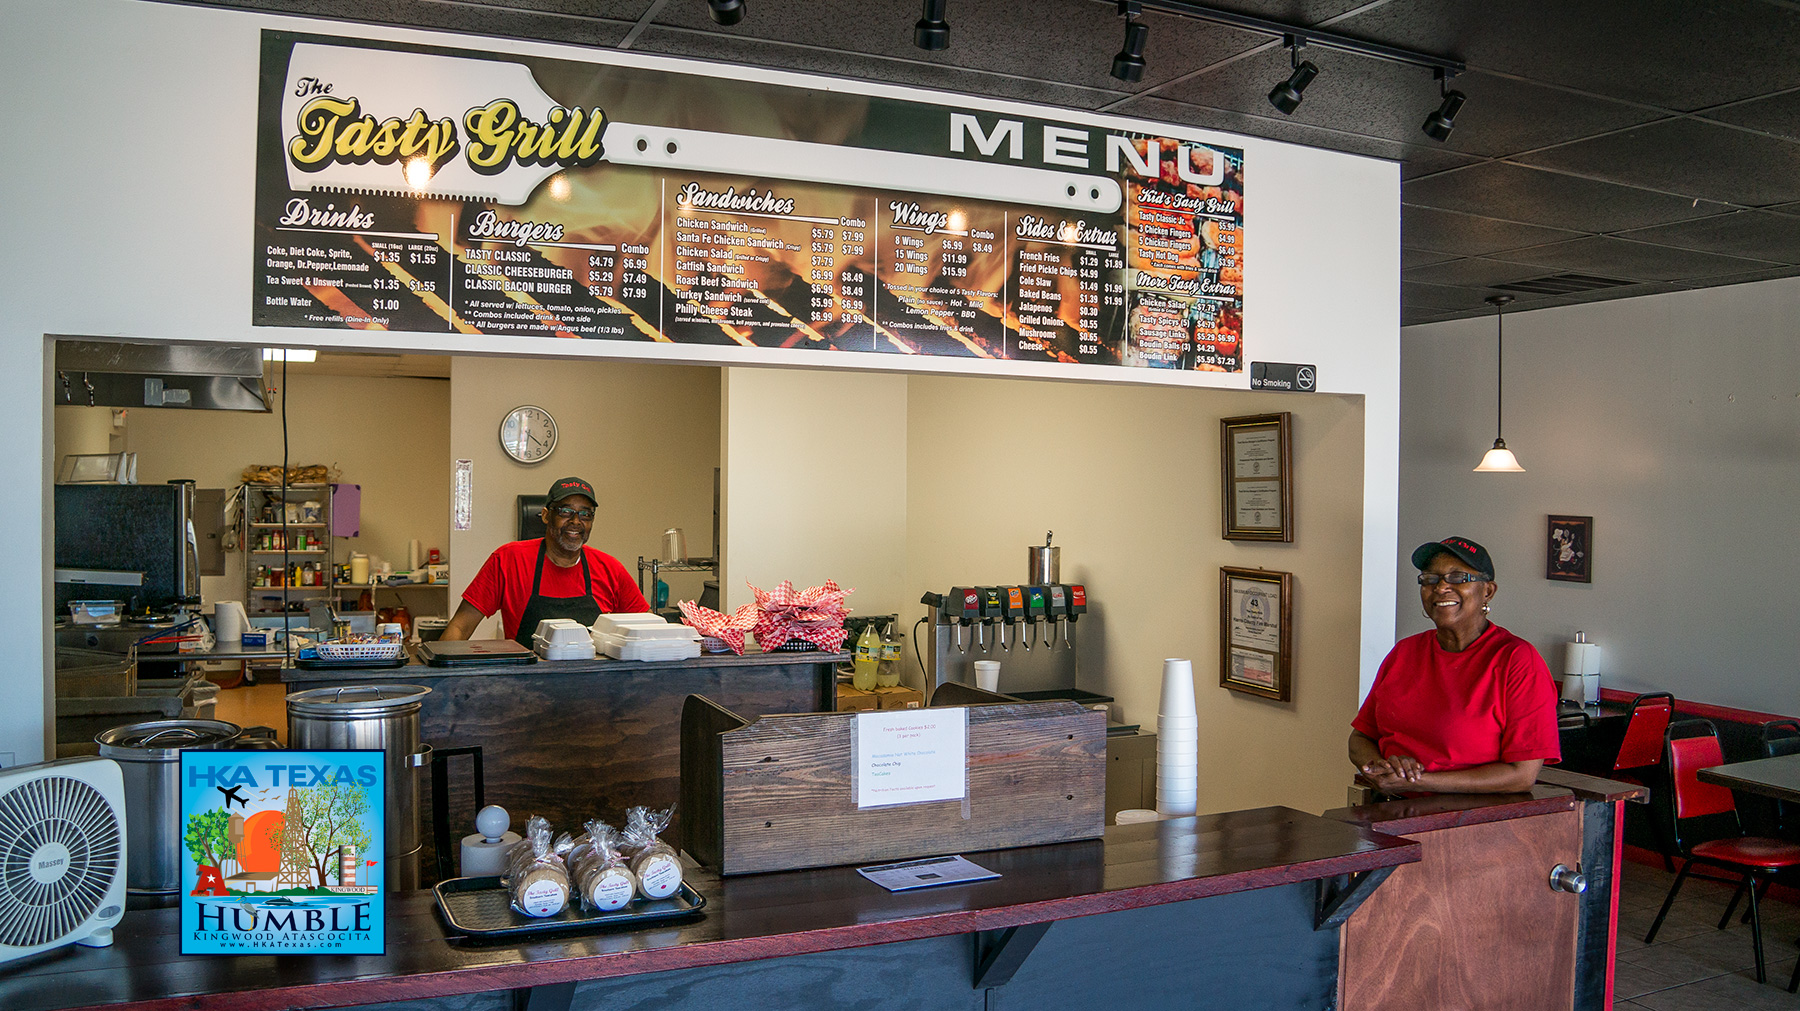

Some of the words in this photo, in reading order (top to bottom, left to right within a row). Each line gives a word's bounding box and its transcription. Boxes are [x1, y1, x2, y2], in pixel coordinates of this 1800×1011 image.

[295, 77, 334, 98] The
[288, 96, 460, 180] Tasty
[463, 97, 606, 176] Grill
[950, 113, 1225, 186] MENU
[677, 182, 795, 214] Sandwiches
[841, 216, 866, 228] Combo
[1138, 188, 1171, 206] Kid's
[1172, 193, 1204, 214] Tasty
[1207, 198, 1234, 214] Grill
[280, 198, 375, 229] Drinks
[890, 201, 948, 234] Wings
[971, 229, 994, 240] Combo
[1139, 211, 1154, 223] Tasty
[1156, 212, 1177, 224] Classic
[1178, 216, 1186, 225] Jr.
[1219, 221, 1235, 232] $5.99
[468, 210, 564, 247] Burgers
[621, 243, 649, 254] Combo
[676, 217, 709, 229] Chicken
[711, 220, 748, 232] Sandwich
[811, 228, 834, 239] $5.79
[842, 230, 864, 242] $7.99
[1016, 214, 1054, 239] Sides
[1075, 220, 1117, 245] Extras
[1139, 224, 1143, 233] 3
[1145, 225, 1168, 236] Chicken
[1169, 228, 1191, 239] Fingers
[1219, 233, 1235, 244] $4.99
[676, 232, 700, 243] Santa
[702, 233, 712, 244] Fe
[714, 234, 745, 246] Chicken
[747, 237, 783, 249] Sandwich
[811, 242, 834, 253] $5.79
[842, 244, 864, 255] $7.99
[895, 236, 899, 245] 8
[902, 236, 924, 248] Wings
[943, 240, 962, 250] $6.99
[973, 243, 992, 253] $8.49
[267, 245, 288, 256] Coke,
[290, 246, 304, 256] Diet
[307, 248, 327, 258] Coke,
[328, 249, 352, 260] Sprite,
[374, 251, 400, 262] $1.35
[410, 253, 436, 264] $1.55
[267, 259, 295, 269] Orange,
[465, 249, 491, 260] TASTY
[494, 251, 531, 262] CLASSIC
[589, 256, 613, 267] $4.79
[623, 258, 647, 270] $6.99
[676, 246, 709, 258] Chicken
[710, 248, 733, 259] Salad
[811, 256, 834, 267] $7.79
[895, 250, 904, 258] 15
[906, 250, 928, 262] Wings
[942, 253, 966, 264] $11.99
[1019, 251, 1042, 260] French
[1044, 252, 1060, 262] Fries
[1080, 256, 1098, 266] $1.29
[1104, 259, 1122, 269] $1.89
[465, 264, 502, 276] CLASSIC
[504, 266, 573, 280] CHEESEBURGER
[588, 271, 613, 282] $5.29
[623, 273, 647, 284] $7.49
[676, 260, 704, 271] Catfish
[706, 262, 744, 274] Sandwich
[811, 270, 833, 281] $6.99
[842, 272, 863, 283] $8.49
[895, 263, 905, 272] 20
[906, 264, 928, 275] Wings
[942, 267, 966, 277] $15.99
[1019, 263, 1036, 272] Fried
[1038, 264, 1058, 275] Pickle
[1060, 266, 1077, 278] Chips
[1080, 269, 1098, 278] $4.99
[266, 276, 280, 285] Tea
[281, 276, 303, 285] Sweet
[305, 277, 311, 285] &
[313, 278, 344, 287] Unsweet
[373, 279, 399, 290] $1.35
[409, 281, 436, 292] $1.55
[465, 279, 502, 291] CLASSIC
[504, 281, 534, 293] BACON
[537, 282, 571, 295] BURGER
[588, 286, 613, 297] $5.79
[622, 288, 646, 299] $7.99
[1019, 276, 1034, 285] Cole
[1036, 277, 1051, 287] Slaw
[1080, 281, 1098, 291] $1.49
[1104, 283, 1122, 293] $1.99
[1137, 271, 1166, 289] More
[1168, 275, 1200, 296] Tasty
[1201, 278, 1235, 295] Extras
[266, 297, 288, 306] Bottle
[290, 297, 312, 306] Water
[373, 299, 399, 310] $1.00
[676, 303, 698, 316] Philly
[700, 305, 728, 316] Cheese
[730, 307, 753, 317] Steak
[810, 311, 832, 322] $6.99
[841, 313, 863, 324] $8.99
[906, 307, 928, 315] Lemon
[930, 308, 954, 317] Pepper
[961, 310, 976, 319] BBQ
[504, 312, 534, 320] included
[535, 313, 553, 321] drink
[1139, 316, 1157, 326] Tasty
[1197, 320, 1215, 329] $4.79
[1252, 378, 1261, 386] No
[1263, 379, 1291, 389] Smoking
[547, 430, 552, 438] 3
[536, 448, 541, 456] 5
[38, 857, 64, 870] Massey
